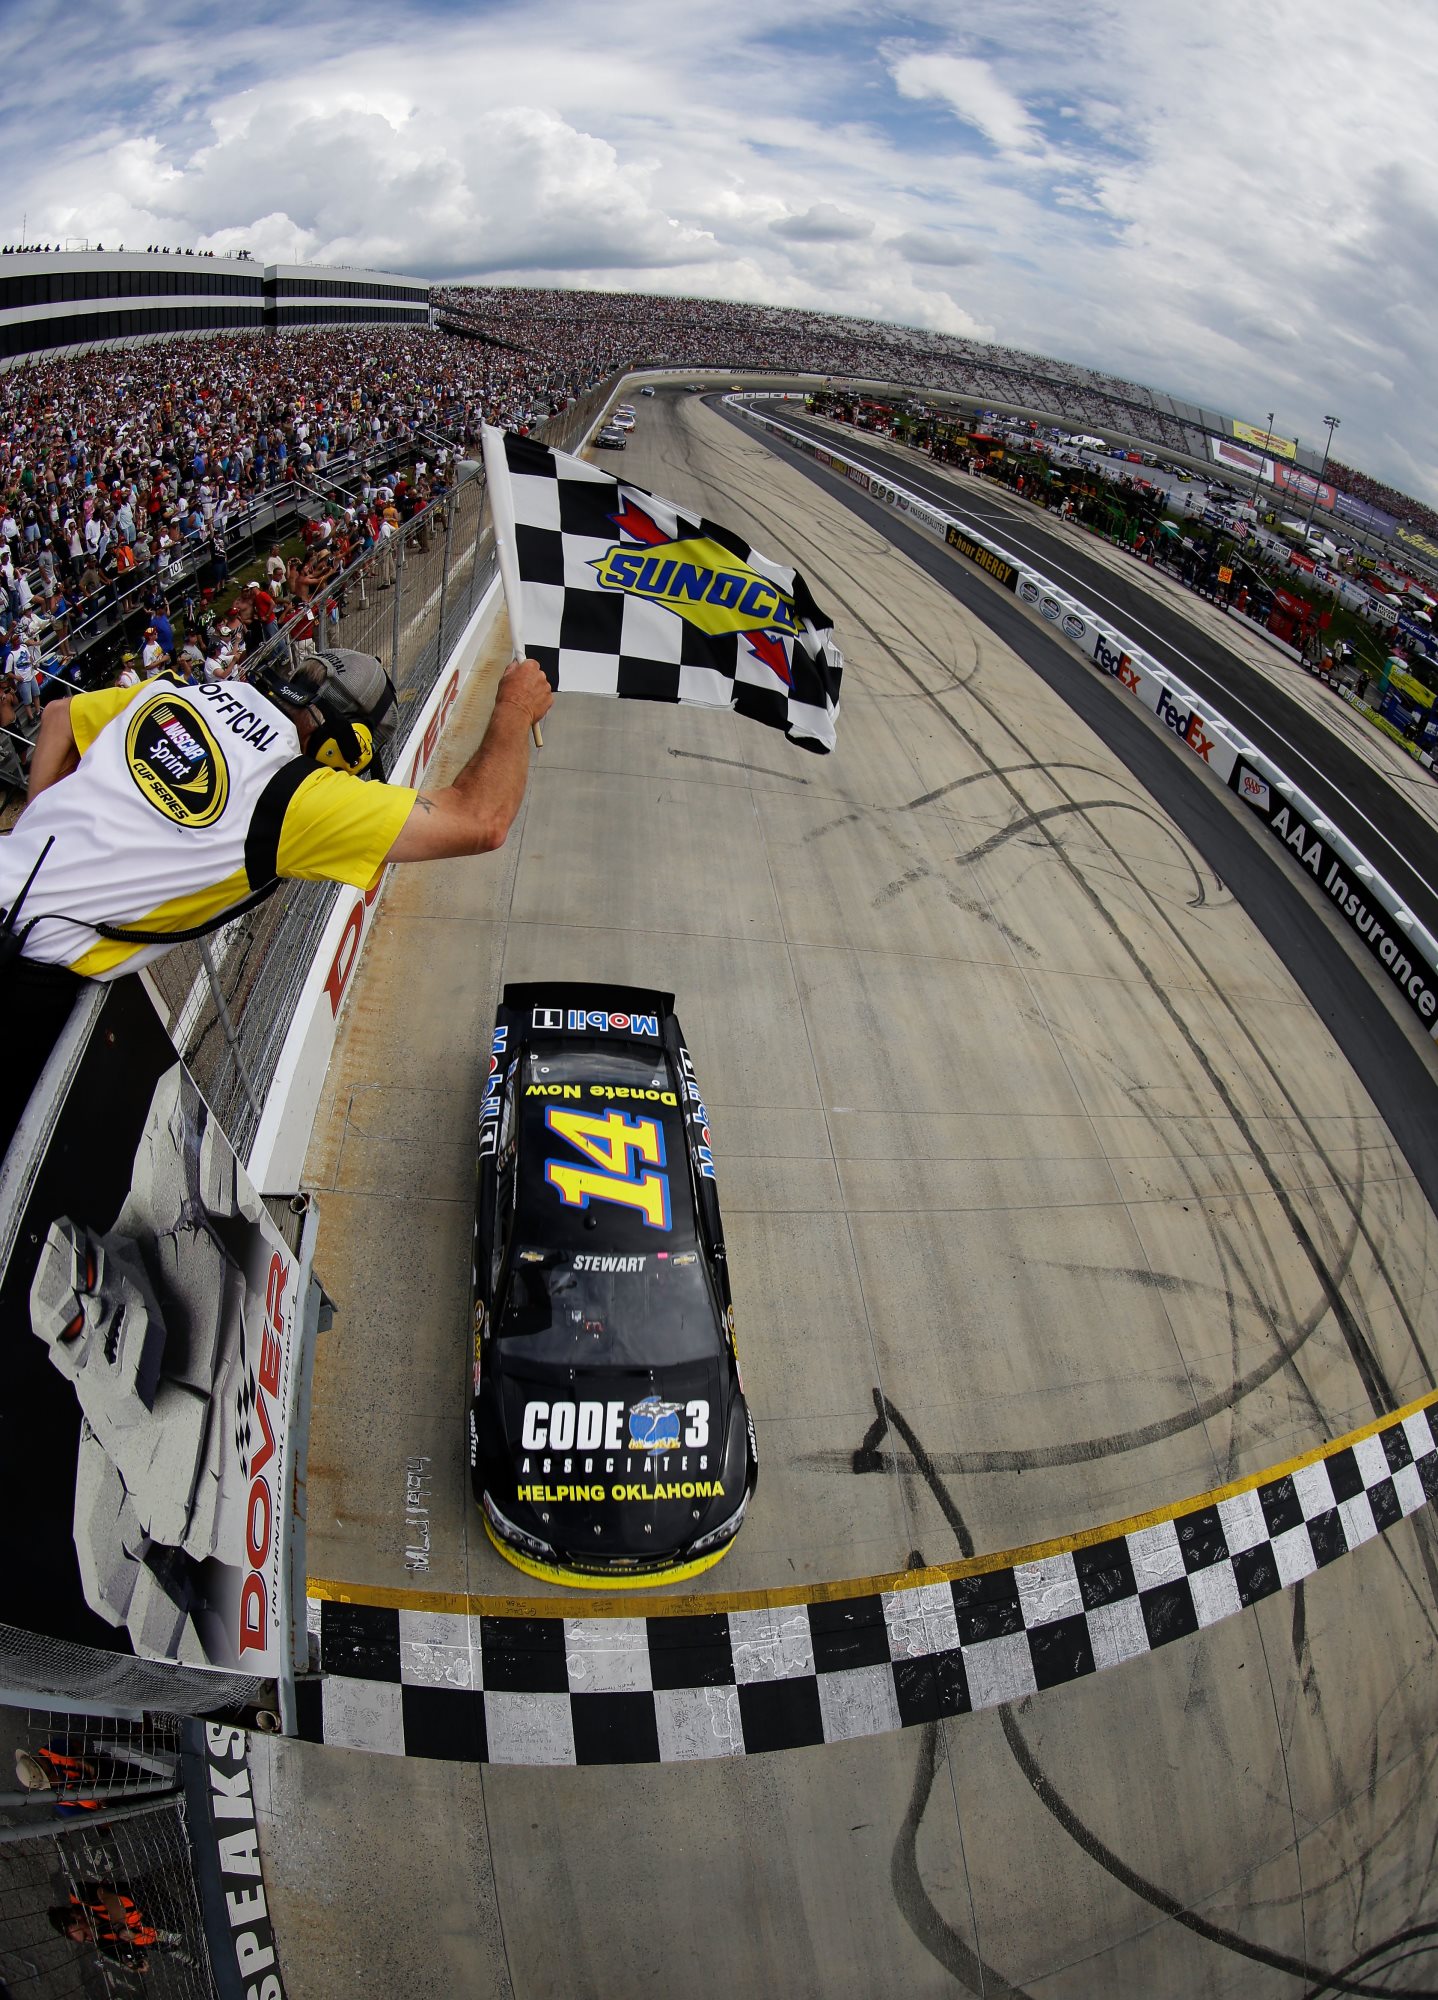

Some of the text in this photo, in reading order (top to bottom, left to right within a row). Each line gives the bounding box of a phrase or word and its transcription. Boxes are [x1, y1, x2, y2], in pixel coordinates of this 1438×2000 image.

[910, 505, 945, 535] #NASCARSALUTES
[170, 560, 183, 577] 101
[948, 528, 1012, 583] 5-hour ENERGY
[1314, 564, 1338, 588] FedEx
[1094, 633, 1141, 694] FedEx
[280, 685, 304, 702] Sprint
[199, 683, 279, 753] OFFICIAL
[1155, 686, 1215, 763] FedEx
[150, 738, 191, 780] Sprint
[162, 721, 207, 764] NASCAR
[132, 761, 190, 820] CUP SERIES
[1244, 776, 1262, 795] AAA
[1271, 807, 1436, 1017] AAA Insurance
[567, 1009, 659, 1037] Mobil
[525, 1084, 678, 1107] Donate Now
[544, 1104, 673, 1233] 14
[573, 1255, 646, 1273] STEWART
[521, 1400, 710, 1451] CODE 3
[238, 1249, 290, 1661] DOVER
[271, 1308, 292, 1615] INTERNATIONAL SPEEDWAY
[522, 1455, 708, 1473] ASSOCIATES
[405, 1456, 432, 1514] 1994
[517, 1480, 725, 1502] HELPING OKLAHOMA
